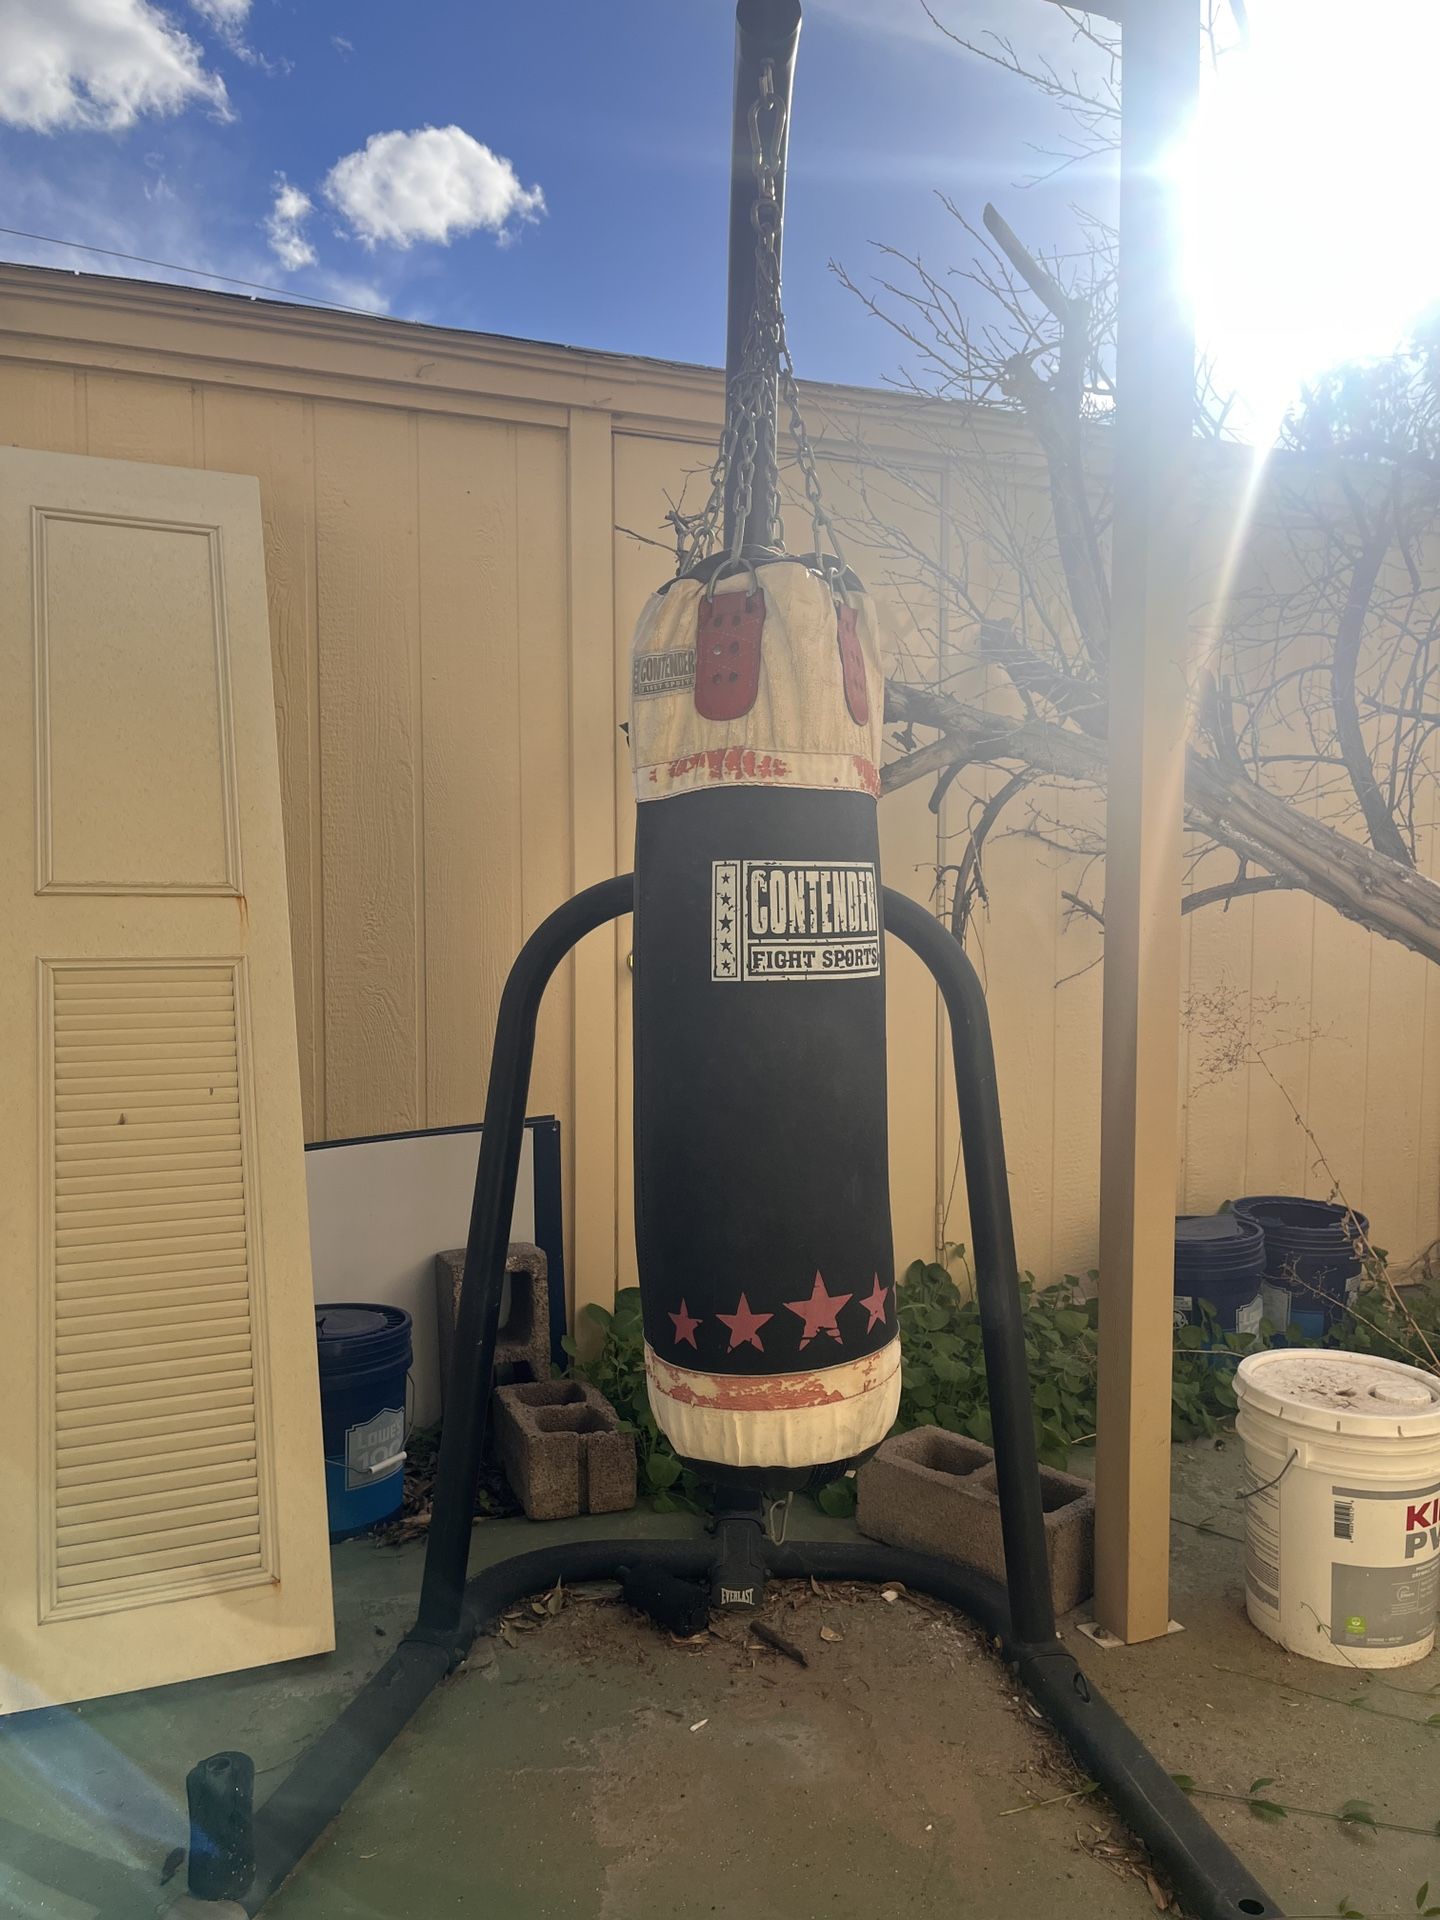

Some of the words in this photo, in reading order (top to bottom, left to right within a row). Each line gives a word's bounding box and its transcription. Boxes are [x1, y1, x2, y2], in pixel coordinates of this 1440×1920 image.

[641, 651, 695, 682] CONTENDER
[750, 869, 877, 935] CONTENDER
[752, 950, 816, 969] FIGHT
[822, 947, 878, 968] SPORTS
[1406, 1498, 1440, 1531] KI
[721, 1587, 754, 1605] EVERLAST
